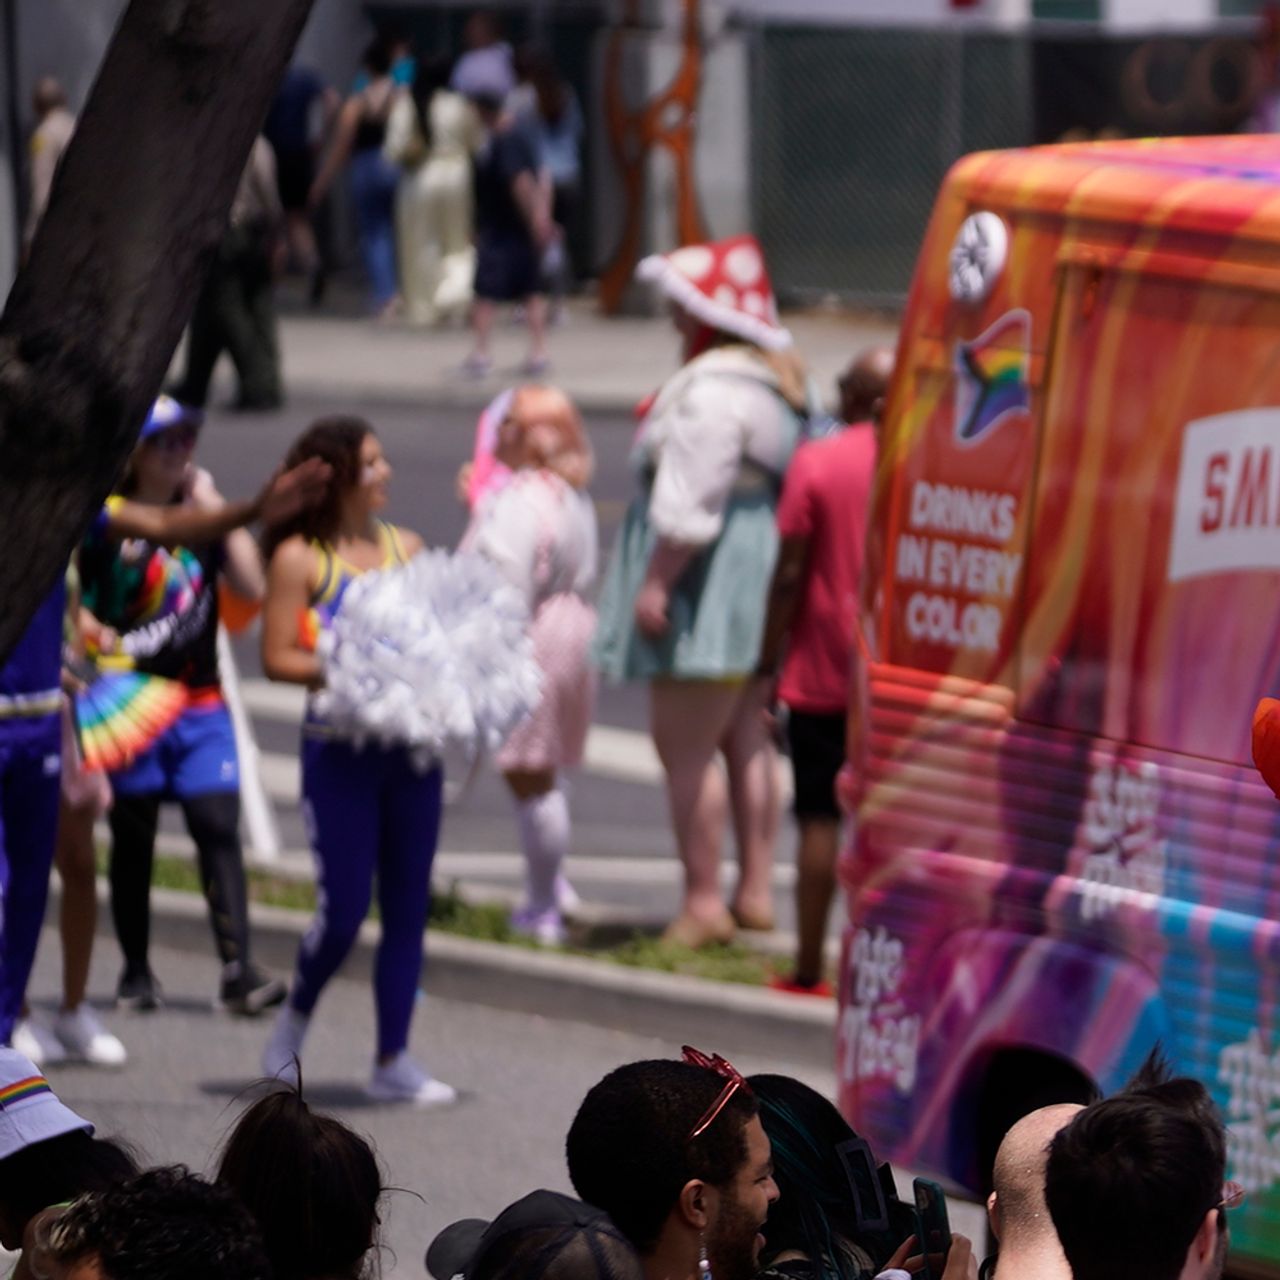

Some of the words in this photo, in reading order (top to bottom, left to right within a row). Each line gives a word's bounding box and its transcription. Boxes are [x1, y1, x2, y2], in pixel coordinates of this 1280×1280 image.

[910, 480, 1015, 541] DRINKS
[896, 534, 928, 582] IN
[930, 539, 1023, 598] EVERY
[906, 592, 1001, 654] COLOR
